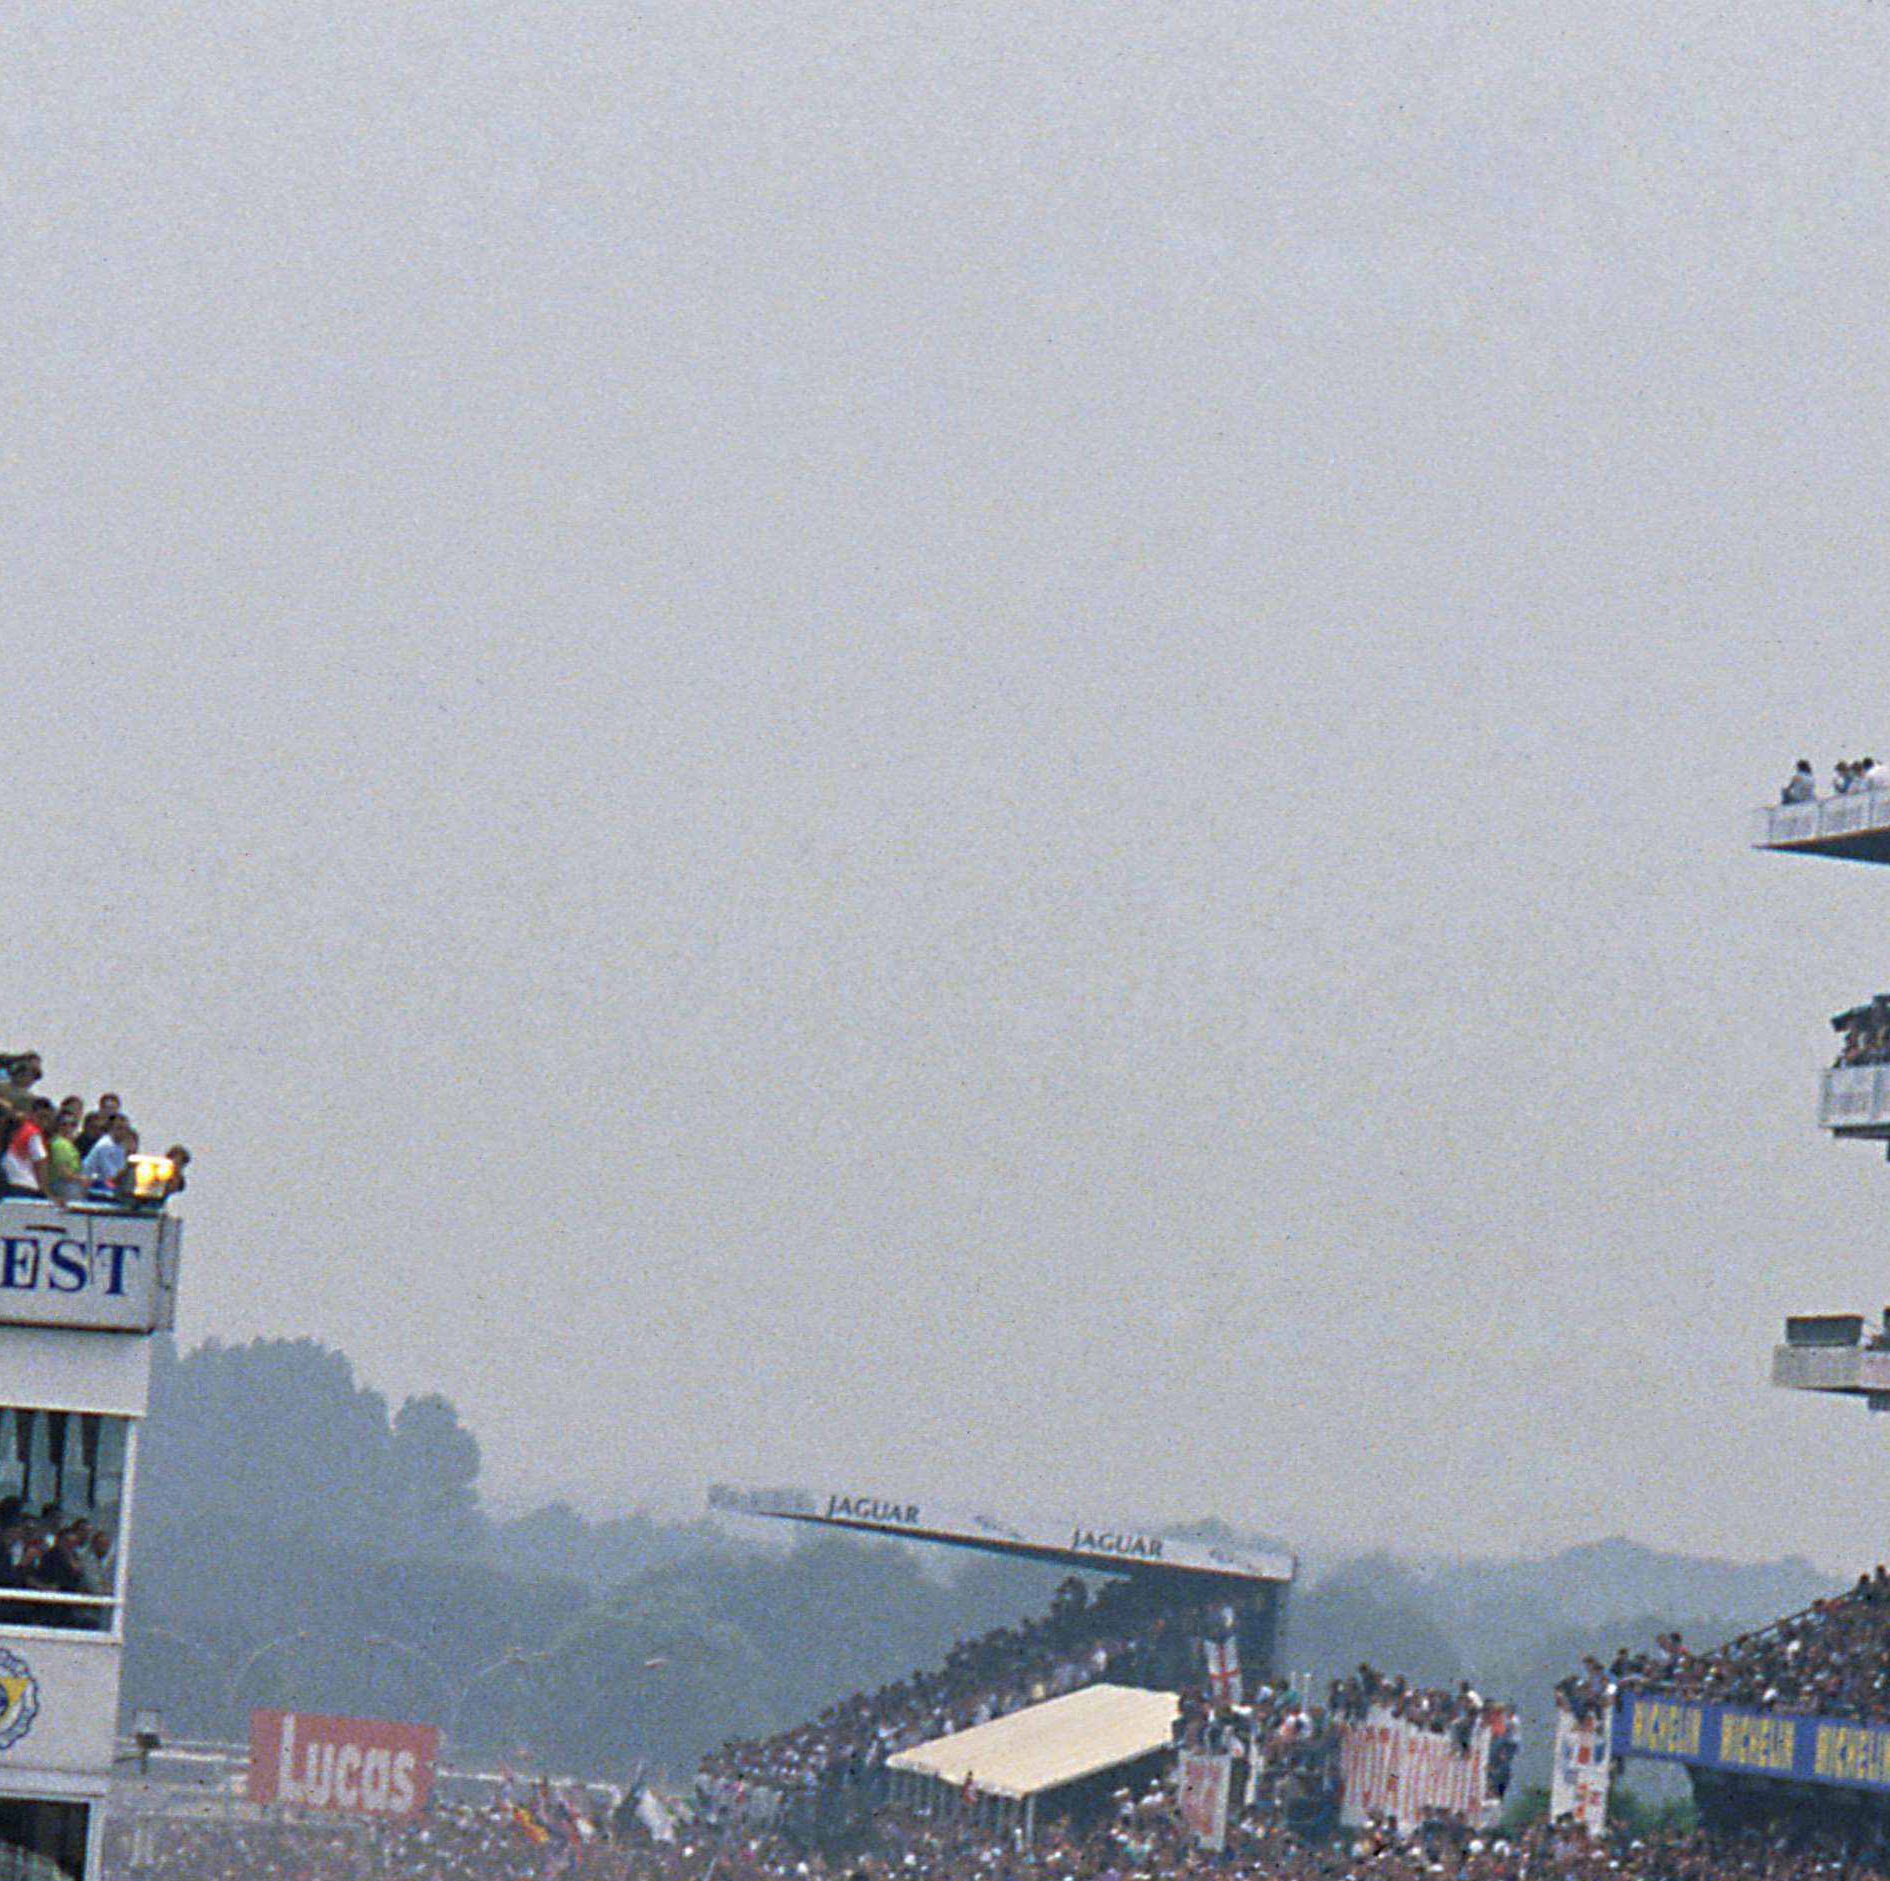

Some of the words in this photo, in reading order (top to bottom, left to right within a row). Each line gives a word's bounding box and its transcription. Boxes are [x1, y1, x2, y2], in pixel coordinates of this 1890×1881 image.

[825, 1493, 920, 1524] JAGUAR
[1070, 1526, 1164, 1558] JAGUAR
[1631, 1701, 1702, 1755] MICHELIN
[1720, 1713, 1795, 1772] MICHELIN
[276, 1711, 419, 1814] Lucas
